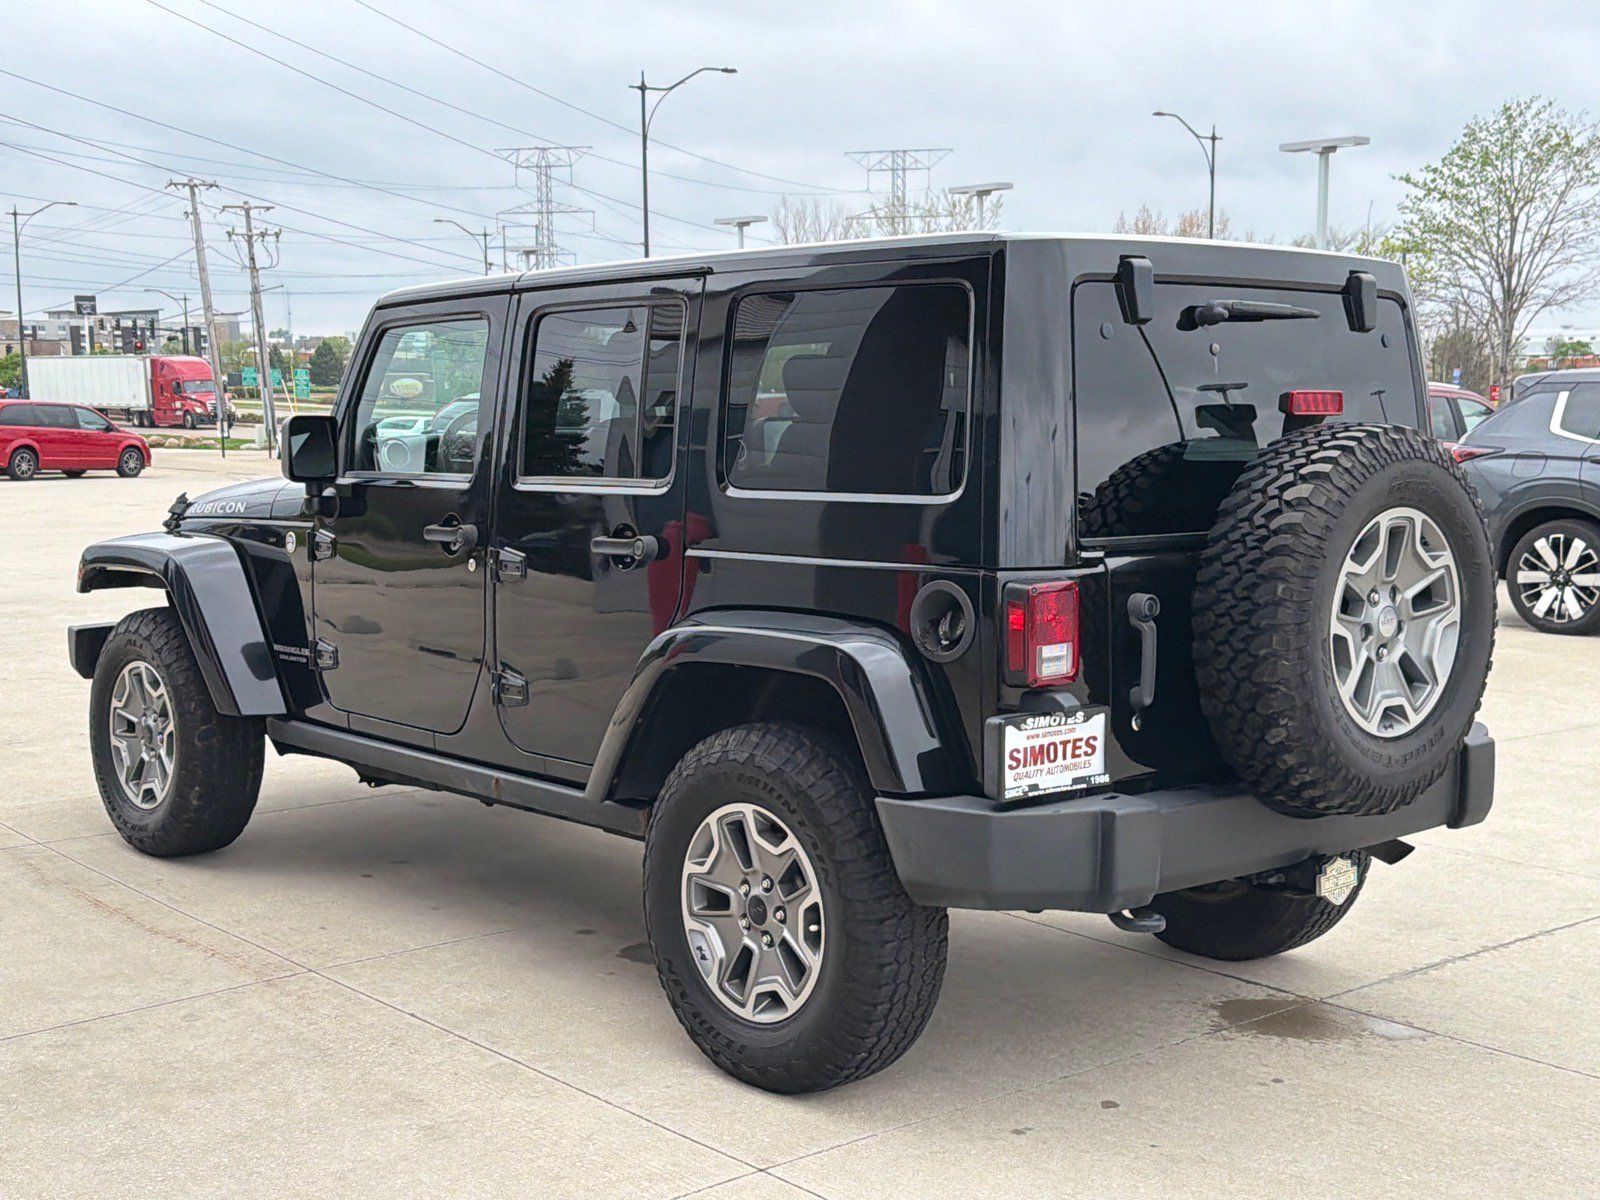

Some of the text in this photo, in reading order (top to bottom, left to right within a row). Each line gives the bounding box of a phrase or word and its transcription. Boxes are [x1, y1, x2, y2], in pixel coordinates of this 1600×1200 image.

[188, 501, 246, 514] RUBICON
[1026, 727, 1077, 741] www.simotes.com
[1007, 735, 1098, 771] SIMOTES
[1013, 760, 1092, 782] QUALITY AUTOMOBILES
